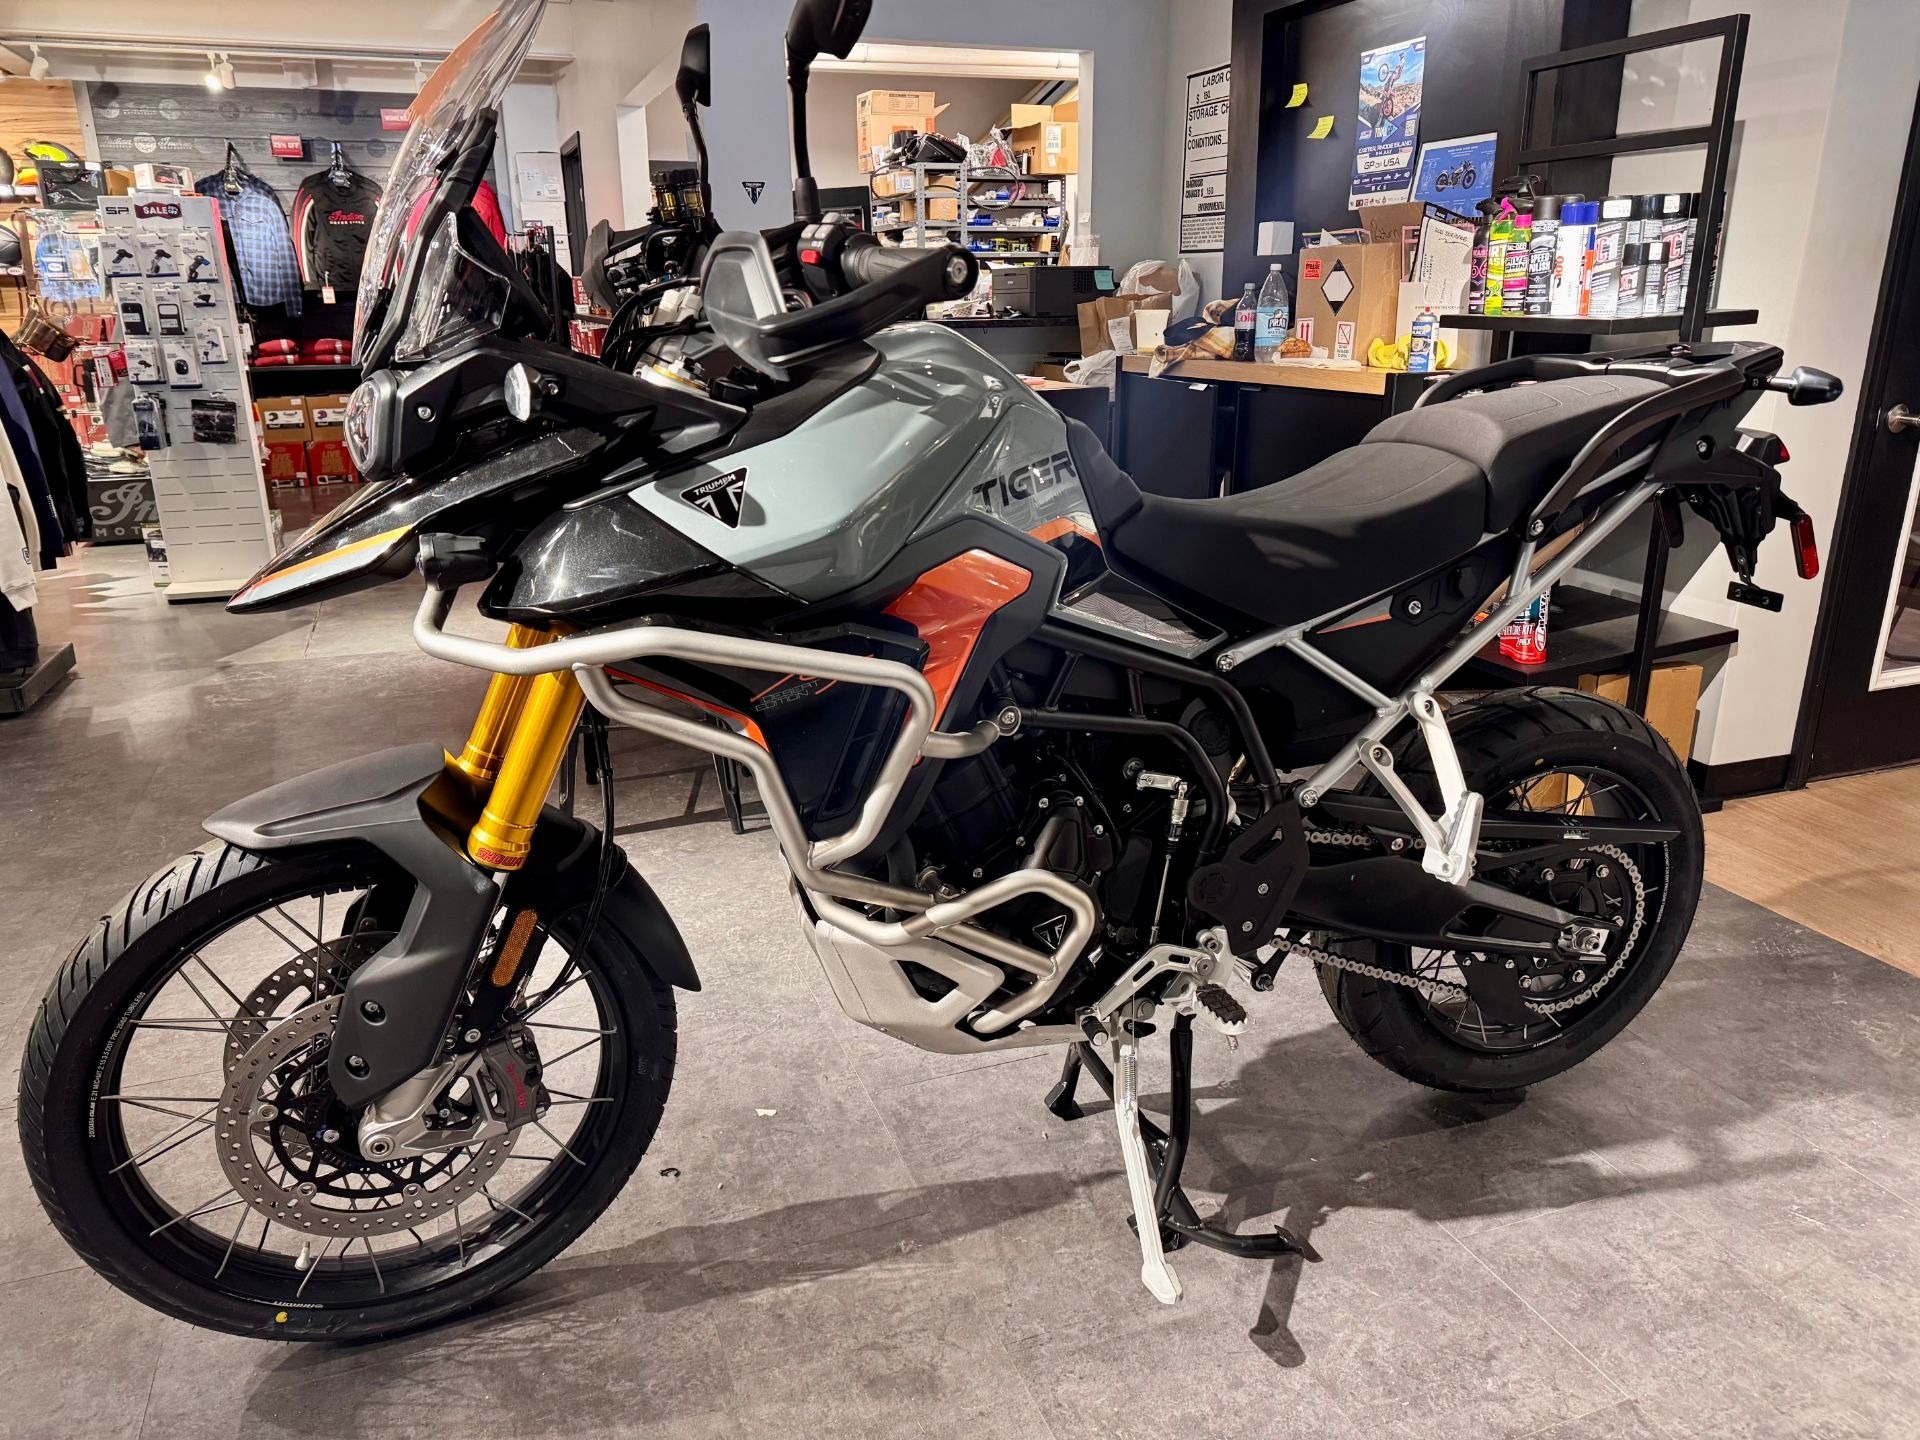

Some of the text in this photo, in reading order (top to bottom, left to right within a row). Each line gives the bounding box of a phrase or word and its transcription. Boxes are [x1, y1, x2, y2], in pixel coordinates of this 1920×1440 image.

[1202, 72, 1224, 88] LABOR
[1188, 104, 1218, 121] STORAGE
[288, 141, 299, 149] OFF
[1187, 134, 1222, 150] CONDITIONS
[1363, 160, 1375, 170] GP
[1383, 157, 1400, 168] USA
[142, 206, 167, 215] SALE
[1530, 252, 1550, 262] SPEED
[1529, 261, 1551, 273] POLISH
[1268, 318, 1288, 328] POLAR
[693, 473, 736, 496] TRIUMPH
[972, 450, 1077, 513] TIGER
[762, 680, 819, 703] DESERT
[755, 689, 809, 712] EDITION
[475, 847, 525, 867] SHOWA
[123, 991, 146, 1017] TUBELESS
